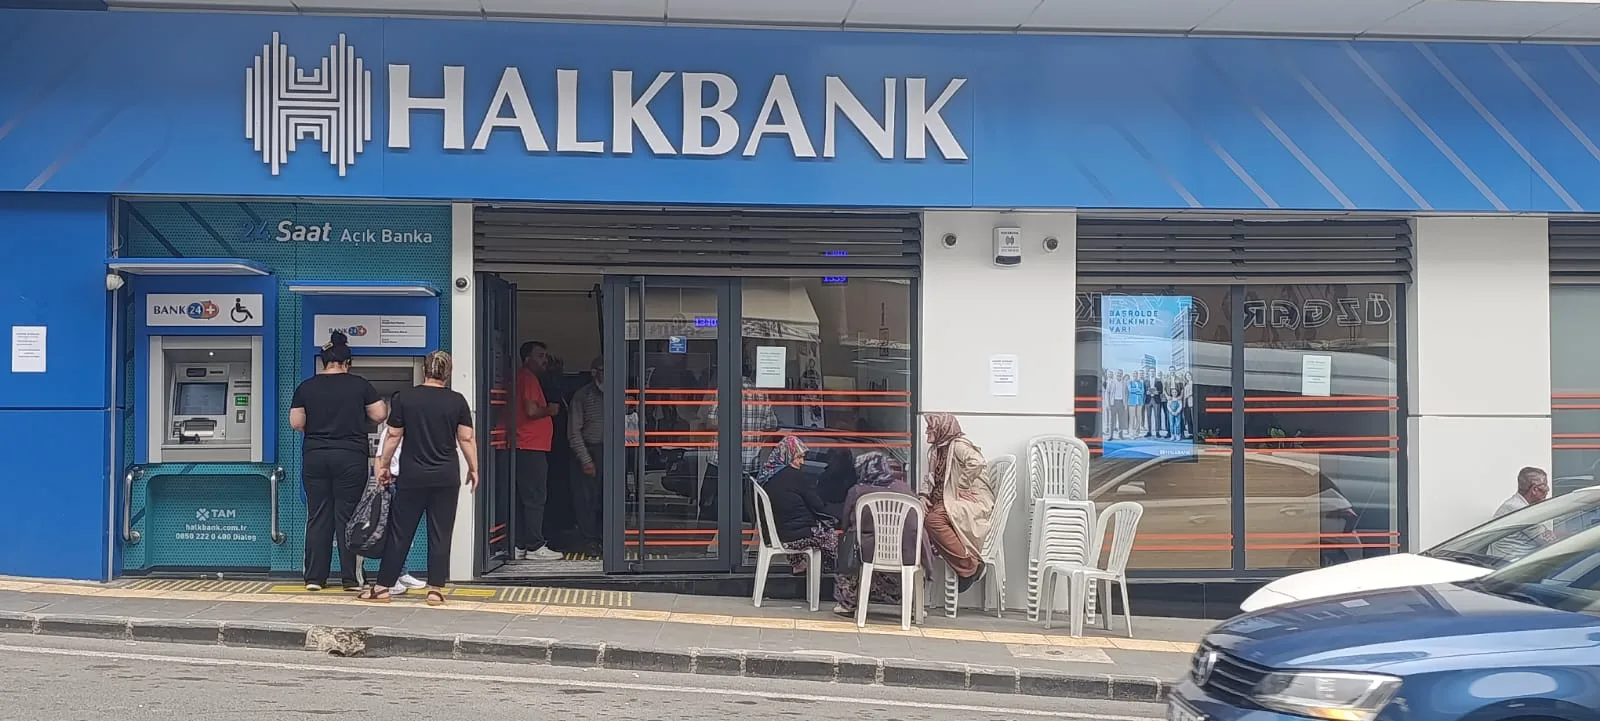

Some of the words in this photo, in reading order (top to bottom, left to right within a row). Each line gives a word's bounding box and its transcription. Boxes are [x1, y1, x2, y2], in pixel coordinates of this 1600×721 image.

[387, 63, 968, 161] HALKBANK
[275, 220, 332, 242] Saat
[340, 228, 377, 246] Açık
[381, 228, 433, 243] Banka
[153, 305, 187, 315] BANK
[189, 305, 203, 315] 24
[211, 509, 236, 518] TAM
[185, 523, 248, 531] halkbank.com.tr
[175, 532, 195, 540] 0850
[232, 533, 257, 541] Dialog
